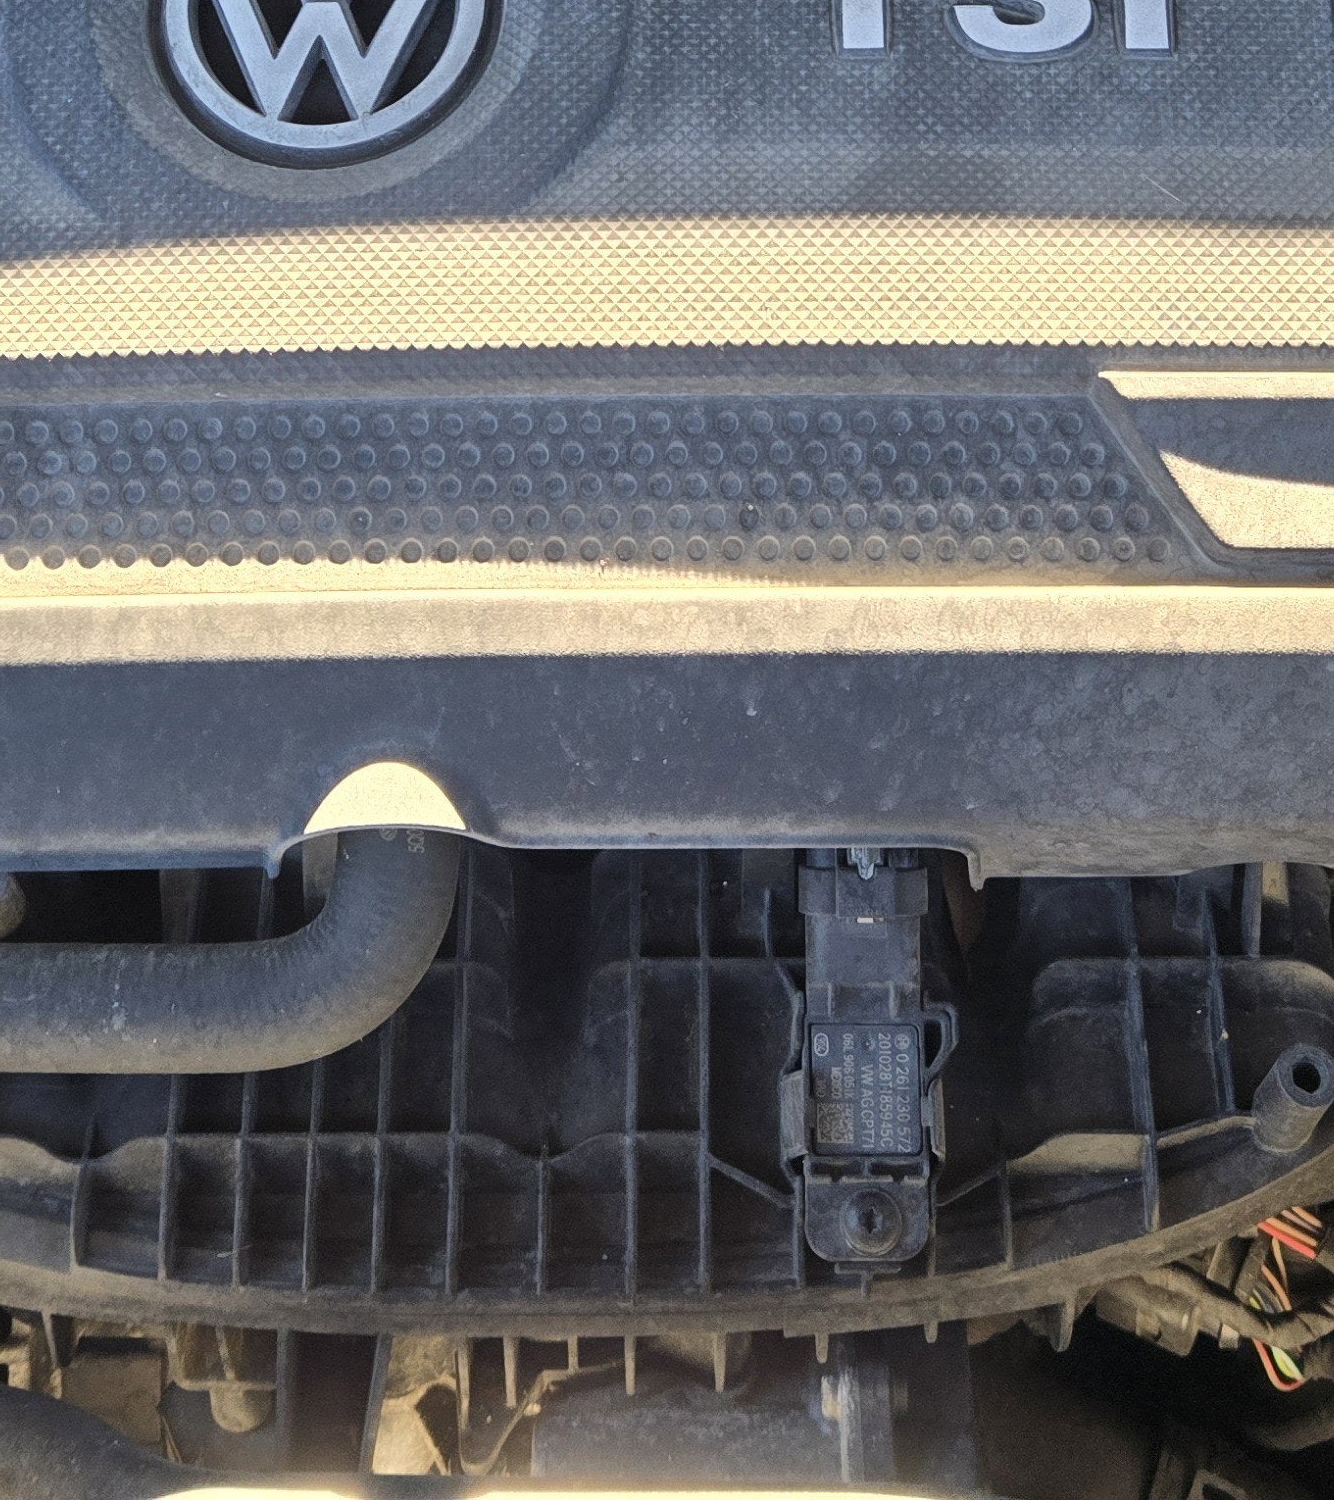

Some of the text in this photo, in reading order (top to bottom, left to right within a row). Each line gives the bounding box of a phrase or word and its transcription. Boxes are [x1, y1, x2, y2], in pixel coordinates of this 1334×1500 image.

[842, 1054, 854, 1074] 906
[860, 1064, 873, 1086] VW
[860, 1088, 873, 1107] AG
[876, 1032, 893, 1147] 201028T185945C
[895, 1053, 911, 1153] 0 261 230 572
